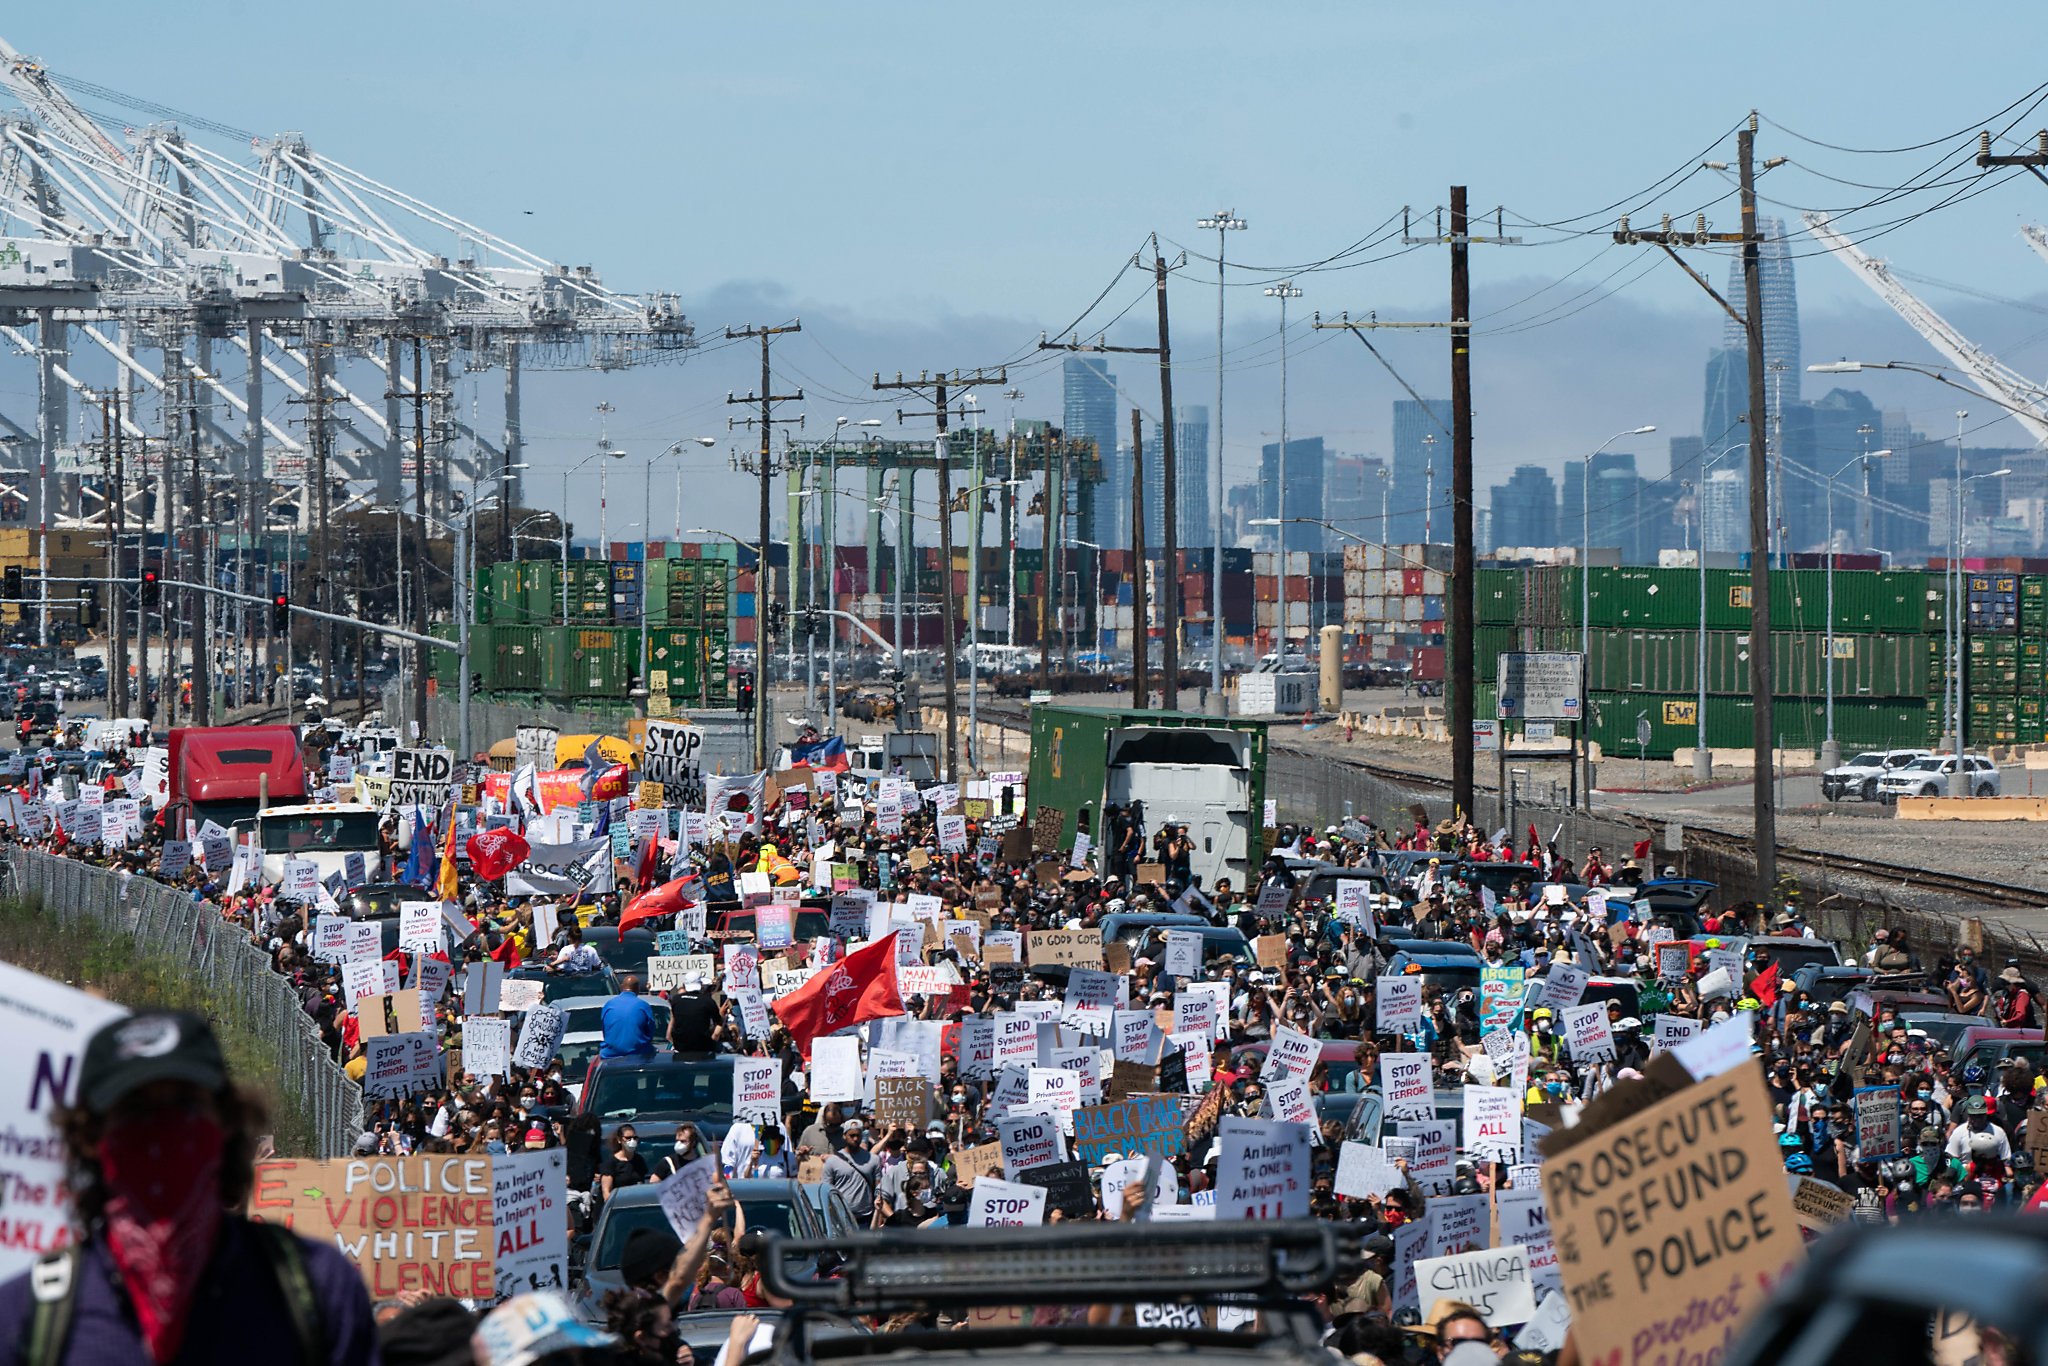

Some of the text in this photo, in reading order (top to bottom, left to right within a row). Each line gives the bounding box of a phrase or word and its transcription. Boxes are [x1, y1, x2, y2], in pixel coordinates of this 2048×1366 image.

[1665, 701, 1693, 721] EMP
[646, 724, 702, 759] STOP
[395, 750, 450, 781] END
[643, 752, 701, 787] POLICE
[390, 782, 451, 805] SYSTEMIC
[601, 781, 622, 792] on
[928, 790, 941, 799] STOP
[943, 820, 960, 829] STOP
[296, 868, 314, 876] STOP
[1264, 892, 1285, 900] STOP
[413, 908, 429, 917] NO
[323, 923, 345, 933] STOP
[358, 928, 371, 938] NO
[953, 926, 971, 935] END
[319, 939, 347, 949] TERROR!
[323, 932, 343, 941] Police
[1031, 933, 1101, 948] NO GOOD COPS
[661, 942, 687, 951] REVOLT
[1055, 951, 1064, 959] in
[423, 966, 439, 976] NO
[656, 959, 709, 971] BLACK LIVES
[776, 971, 810, 986] Black
[904, 969, 936, 980] MANY
[1089, 978, 1107, 986] Injury
[1481, 967, 1524, 982] ABOLISH
[1560, 972, 1575, 984] NO
[355, 987, 376, 1000] ALL
[1083, 991, 1101, 1000] Injury
[1391, 983, 1407, 995] NO
[1483, 983, 1504, 994] POLICE
[1075, 999, 1101, 1011] ALL
[1182, 1002, 1208, 1014] STOP
[421, 1016, 434, 1027] ALL
[1182, 1013, 1206, 1024] Police
[1573, 1012, 1599, 1029] STOP
[1005, 1020, 1031, 1034] END
[1124, 1019, 1148, 1034] STOP
[1178, 1021, 1211, 1033] TERROR!
[1577, 1024, 1600, 1038] Police
[1666, 1026, 1690, 1038] END
[997, 1033, 1037, 1047] Systemic
[1125, 1032, 1148, 1044] Police
[1573, 1031, 1607, 1048] TERROR!
[376, 1044, 405, 1060] STOP
[1000, 1043, 1035, 1057] Racism!
[1283, 1039, 1308, 1055] END
[376, 1057, 403, 1070] Police
[889, 1059, 906, 1068] Injury
[1061, 1056, 1090, 1070] STOP
[1272, 1048, 1312, 1066] Systemic
[370, 1065, 408, 1080] TERROR!
[743, 1068, 772, 1083] STOP
[886, 1066, 898, 1074] ONE
[1391, 1064, 1422, 1078] STOP
[743, 1082, 770, 1093] Police
[879, 1080, 925, 1096] BLACK
[1046, 1077, 1064, 1089] NO
[1394, 1078, 1421, 1089] Police
[738, 1090, 776, 1102] TERROR!
[1279, 1087, 1302, 1107] STOP
[1388, 1085, 1428, 1101] TERROR!
[879, 1095, 922, 1110] TRANS
[883, 1110, 917, 1119] LIVES
[1283, 1102, 1304, 1119] Police
[1073, 1096, 1183, 1141] BLACK TRANS
[1013, 1125, 1043, 1143] END
[1478, 1122, 1507, 1137] ALL
[1861, 1121, 1891, 1141] SKIN
[1006, 1139, 1054, 1158] Systemic
[1078, 1129, 1186, 1168] LIVES MATTER
[1243, 1141, 1294, 1160] An Injury
[1549, 1085, 1746, 1222] PROSECUTE
[1011, 1151, 1053, 1169] Racism!
[344, 1160, 489, 1195] POLICE
[512, 1168, 545, 1190] Injury
[1242, 1164, 1281, 1180] To ONE
[510, 1188, 534, 1206] ONE
[535, 1183, 546, 1196] Is
[1233, 1186, 1249, 1200] An
[1252, 1181, 1284, 1200] Injury
[1286, 1178, 1298, 1192] To
[1596, 1147, 1748, 1248] DEFUND
[325, 1197, 493, 1230] VIOLENCE
[505, 1196, 552, 1223] Injury To
[985, 1199, 1030, 1215] STOP
[1442, 1206, 1476, 1221] An Injury
[985, 1216, 1024, 1228] Police
[1442, 1219, 1468, 1232] To ONE
[497, 1222, 545, 1259] ALL
[1436, 1226, 1481, 1245] An Injury To
[336, 1229, 483, 1260] WHITE
[1403, 1230, 1429, 1265] STOP
[1571, 1270, 1616, 1313] THE
[1632, 1191, 1773, 1294] POLICE
[1430, 1256, 1526, 1291] CHINGA
